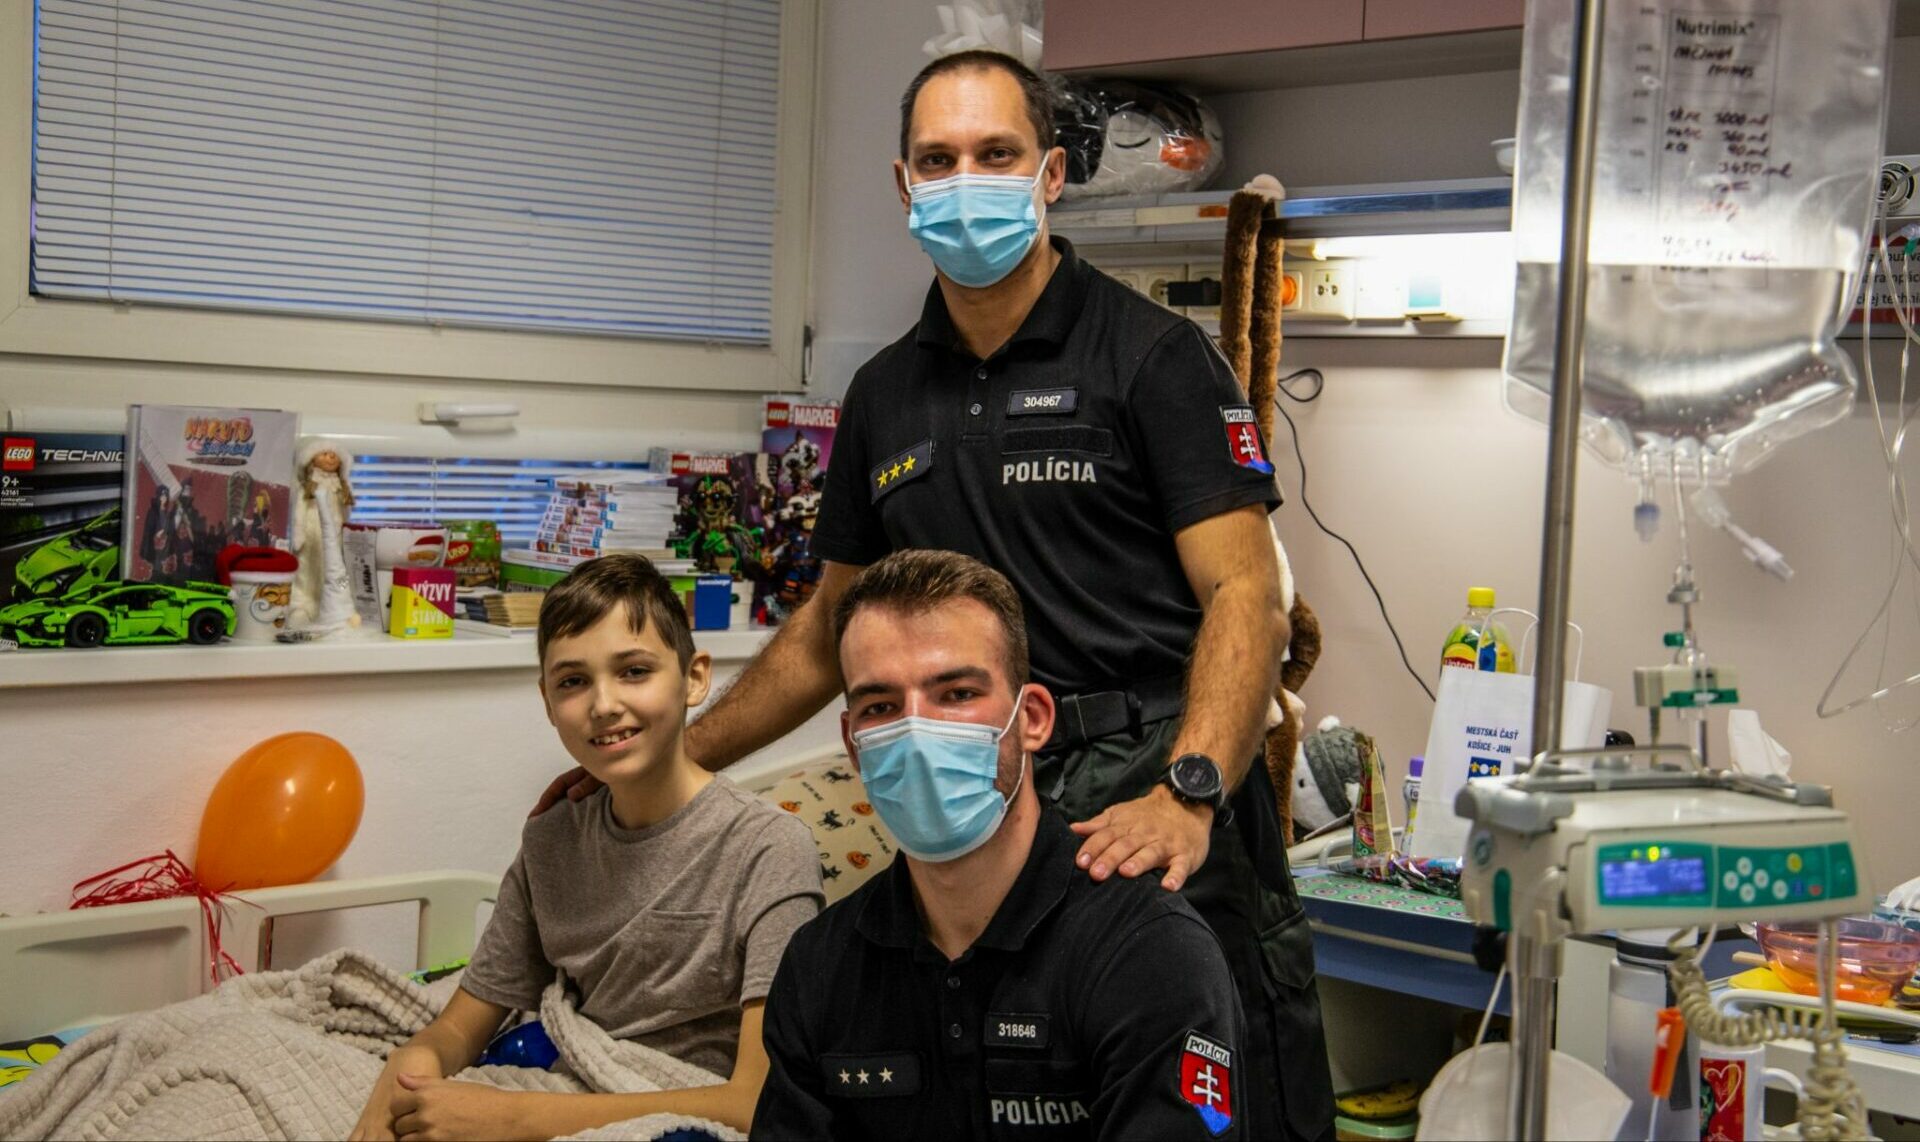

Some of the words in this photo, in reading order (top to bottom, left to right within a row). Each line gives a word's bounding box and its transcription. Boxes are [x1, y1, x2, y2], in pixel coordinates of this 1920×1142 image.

[1023, 395, 1062, 408] 304967
[794, 406, 837, 428] MARVEL
[5, 447, 33, 460] LEGO
[42, 449, 124, 462] TECHNIC
[694, 457, 729, 474] MARVEL
[1002, 457, 1097, 485] POLÍCIA
[2, 475, 20, 487] 9+
[412, 580, 452, 602] VÝZVY
[1466, 725, 1498, 737] MESTSKÁ
[1467, 739, 1491, 751] KOŠICE
[1496, 745, 1512, 754] JUH
[998, 1023, 1036, 1038] 318646
[1189, 1039, 1230, 1064] POLÍCIA
[991, 1096, 1090, 1125] POLÍCIA
